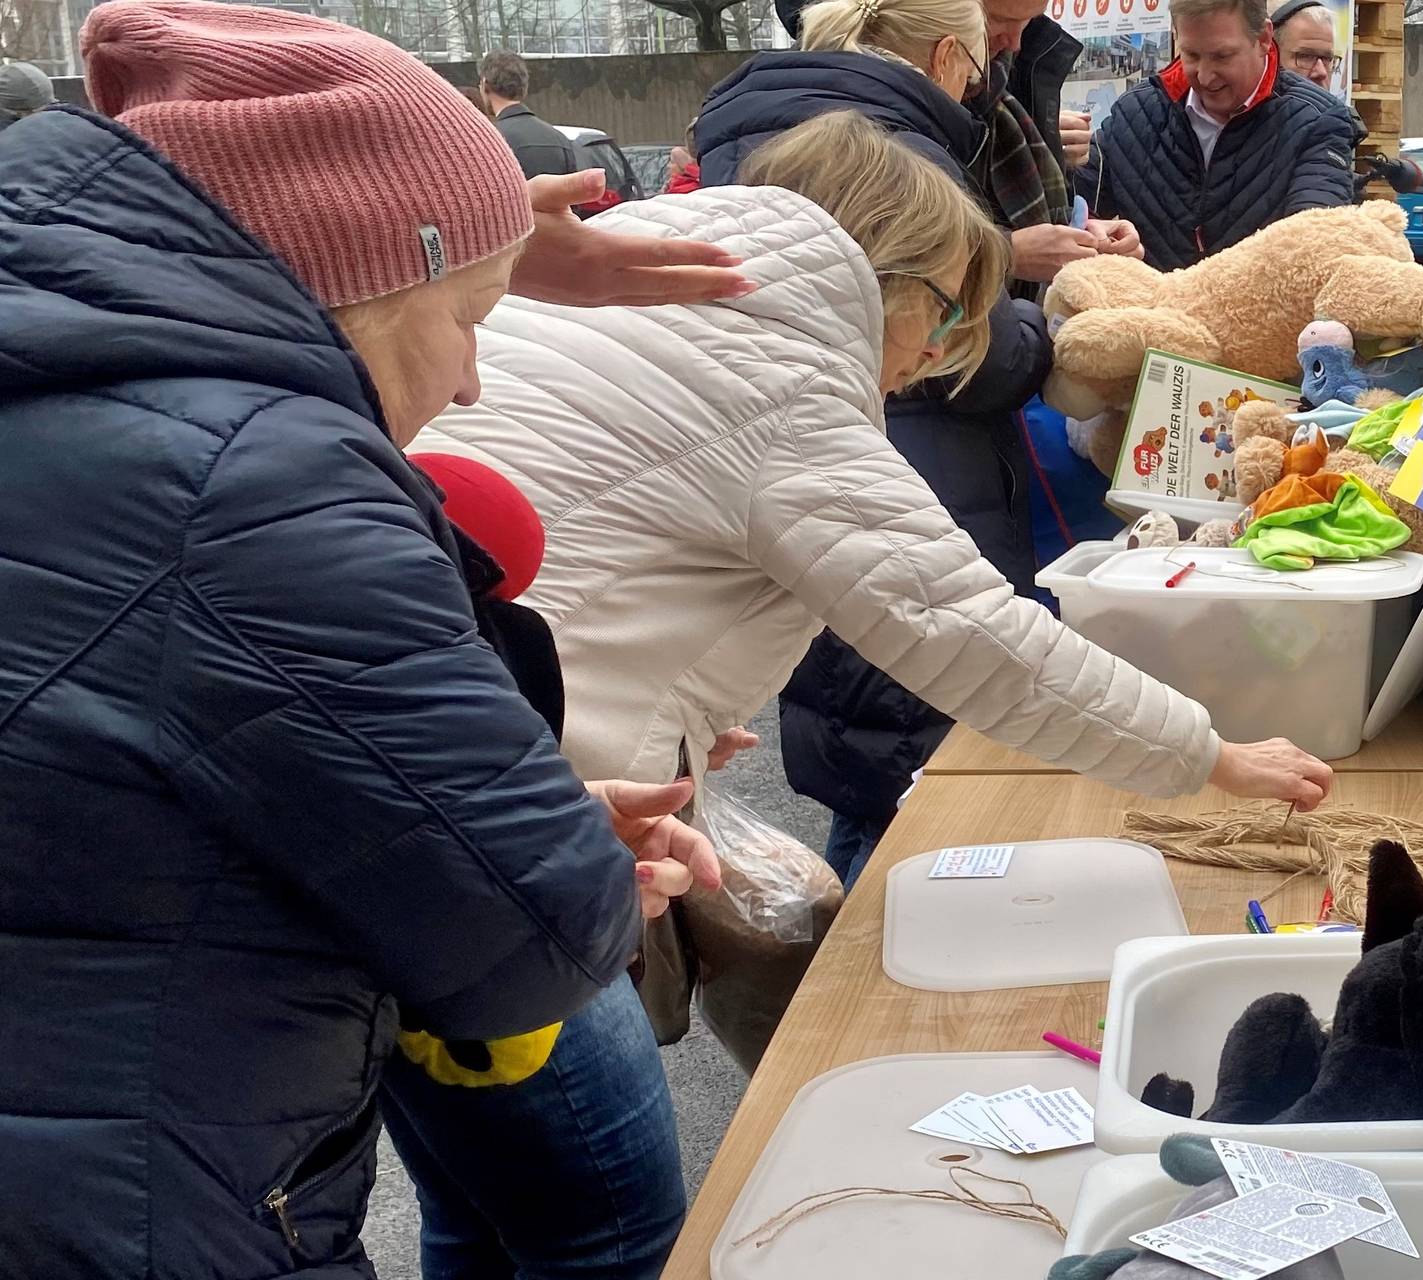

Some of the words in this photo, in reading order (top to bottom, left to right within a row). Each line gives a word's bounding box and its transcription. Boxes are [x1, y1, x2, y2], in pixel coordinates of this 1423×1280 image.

[1171, 364, 1185, 410] WAUZIS
[1169, 413, 1182, 440] DER
[1167, 442, 1180, 474] WELT
[1166, 477, 1178, 497] DIE
